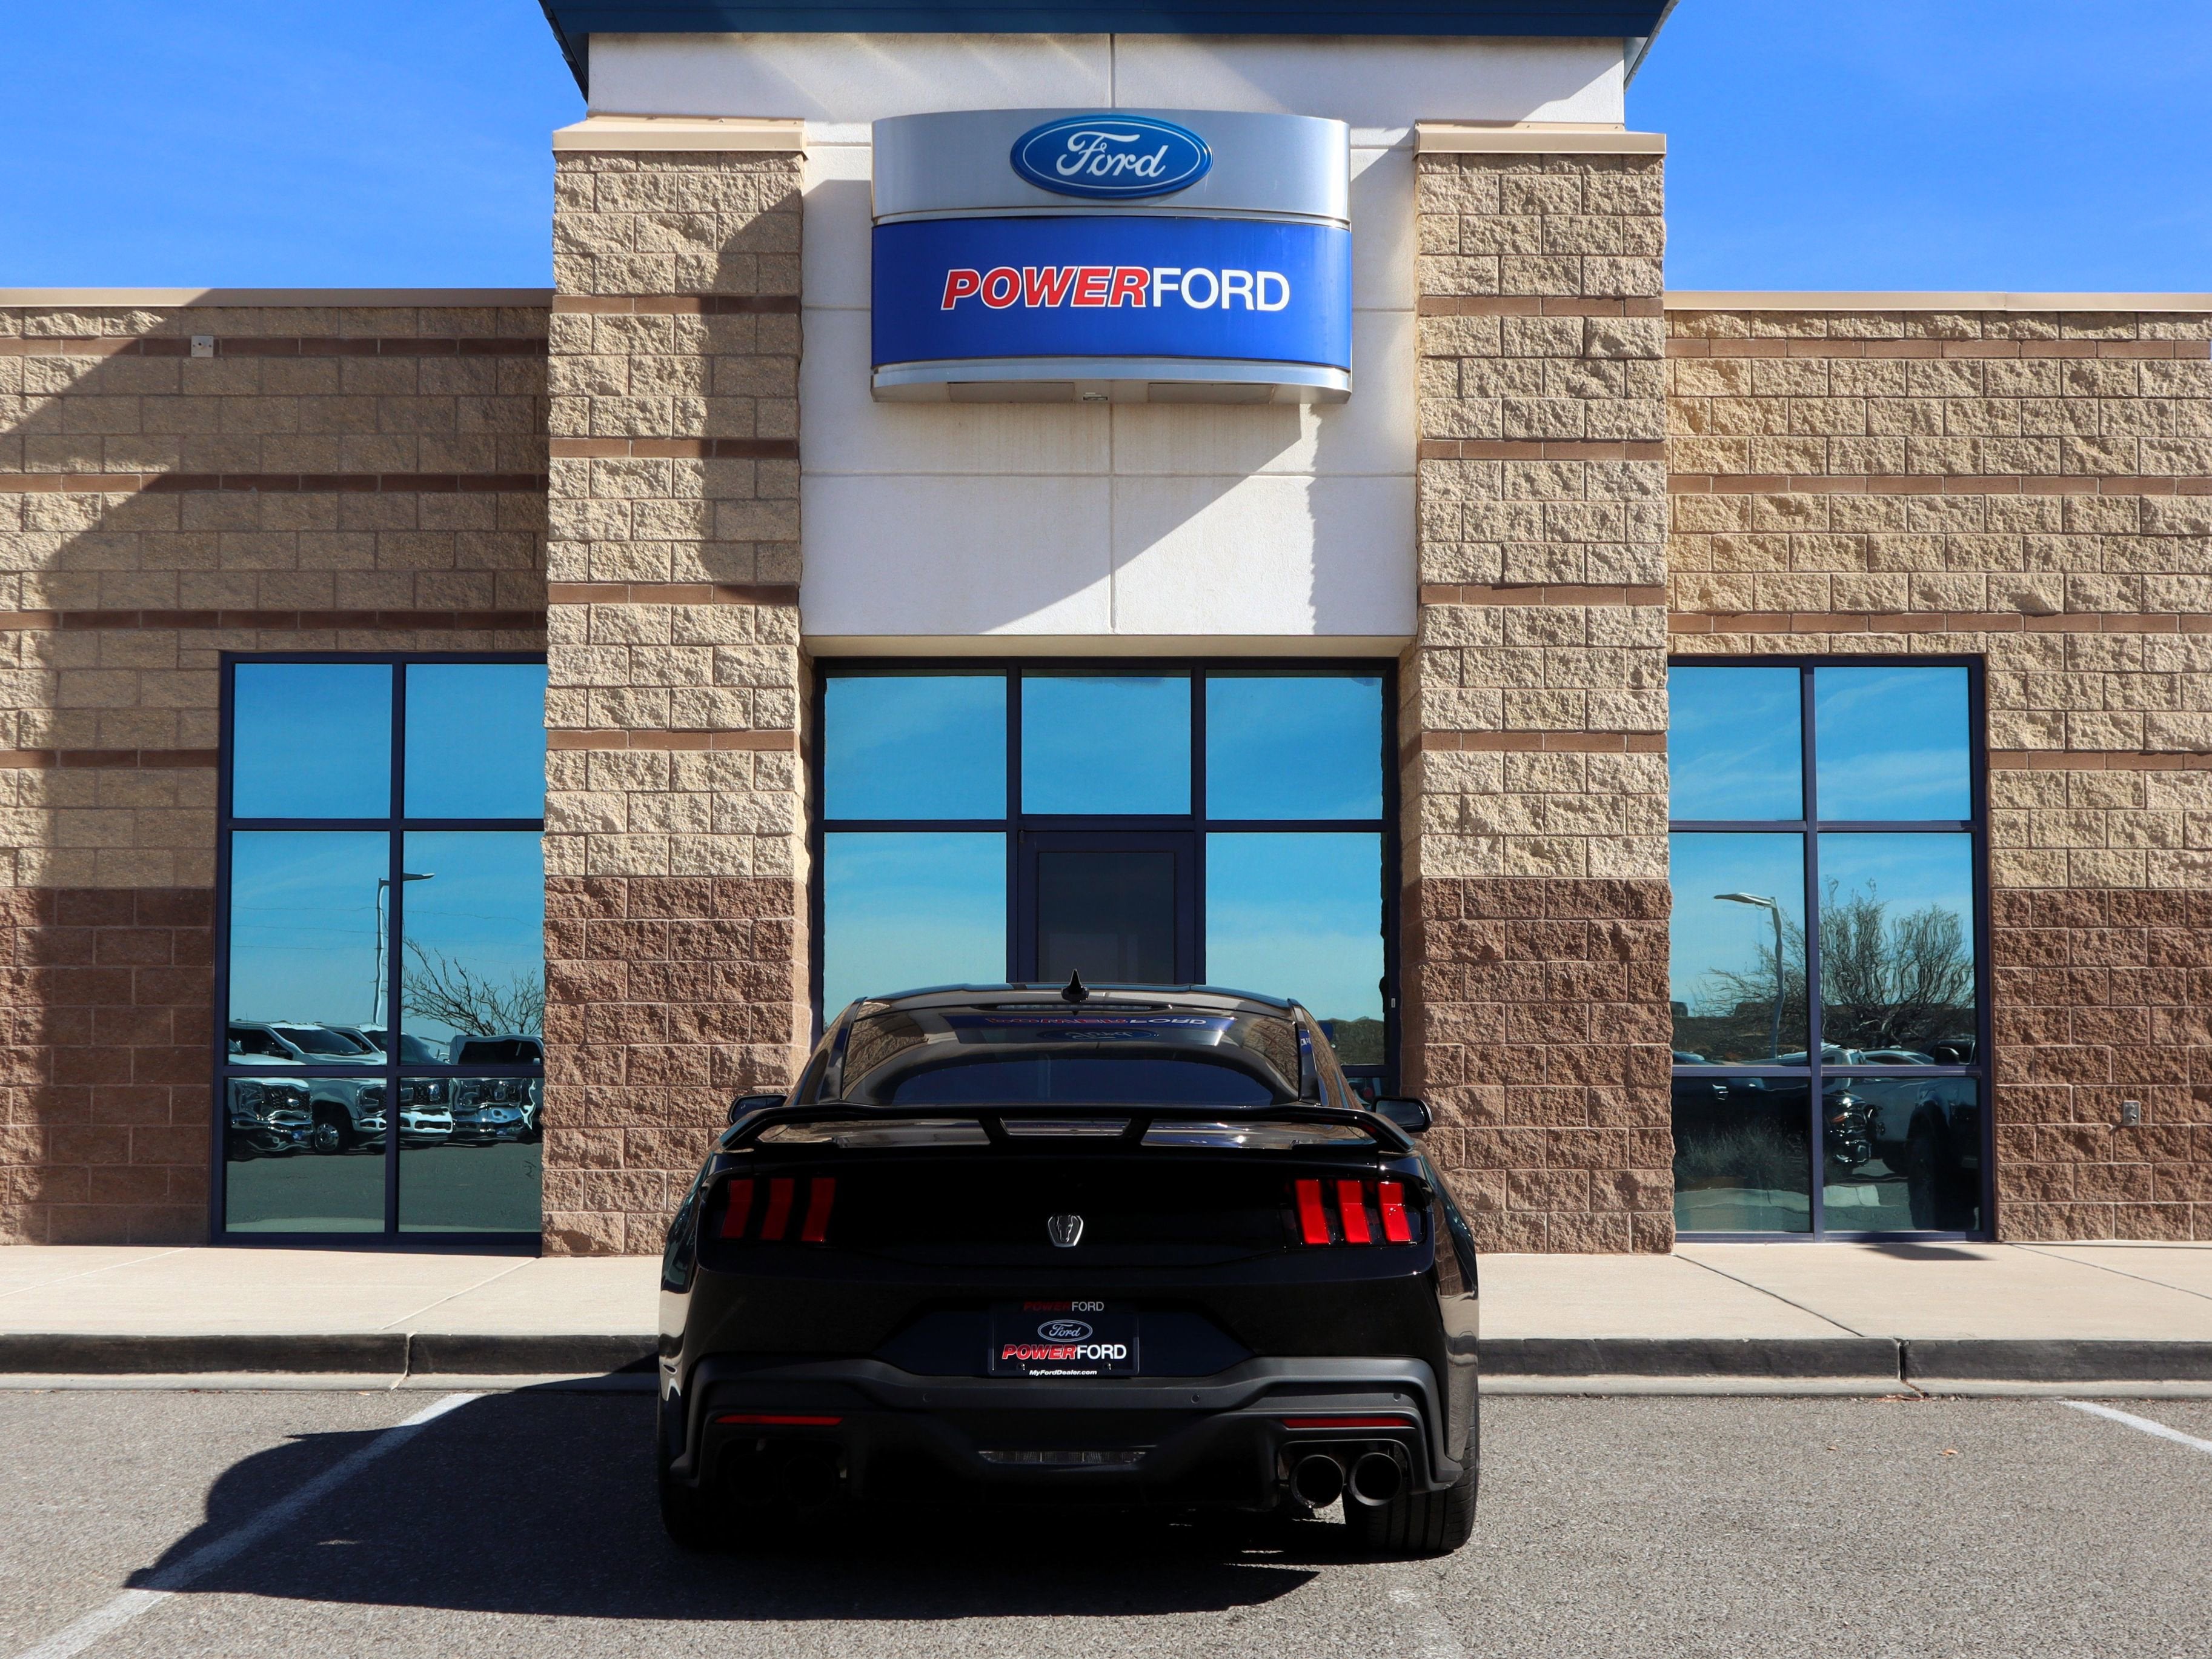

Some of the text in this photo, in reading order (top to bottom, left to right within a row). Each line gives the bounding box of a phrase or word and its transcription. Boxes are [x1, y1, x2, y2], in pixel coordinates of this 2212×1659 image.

[1055, 131, 1168, 178] Ford
[940, 265, 1290, 311] POWERFORD
[1023, 1302, 1104, 1312] POWERFORD
[1049, 1323, 1081, 1337] Ford
[1001, 1344, 1127, 1360] POWERFORD
